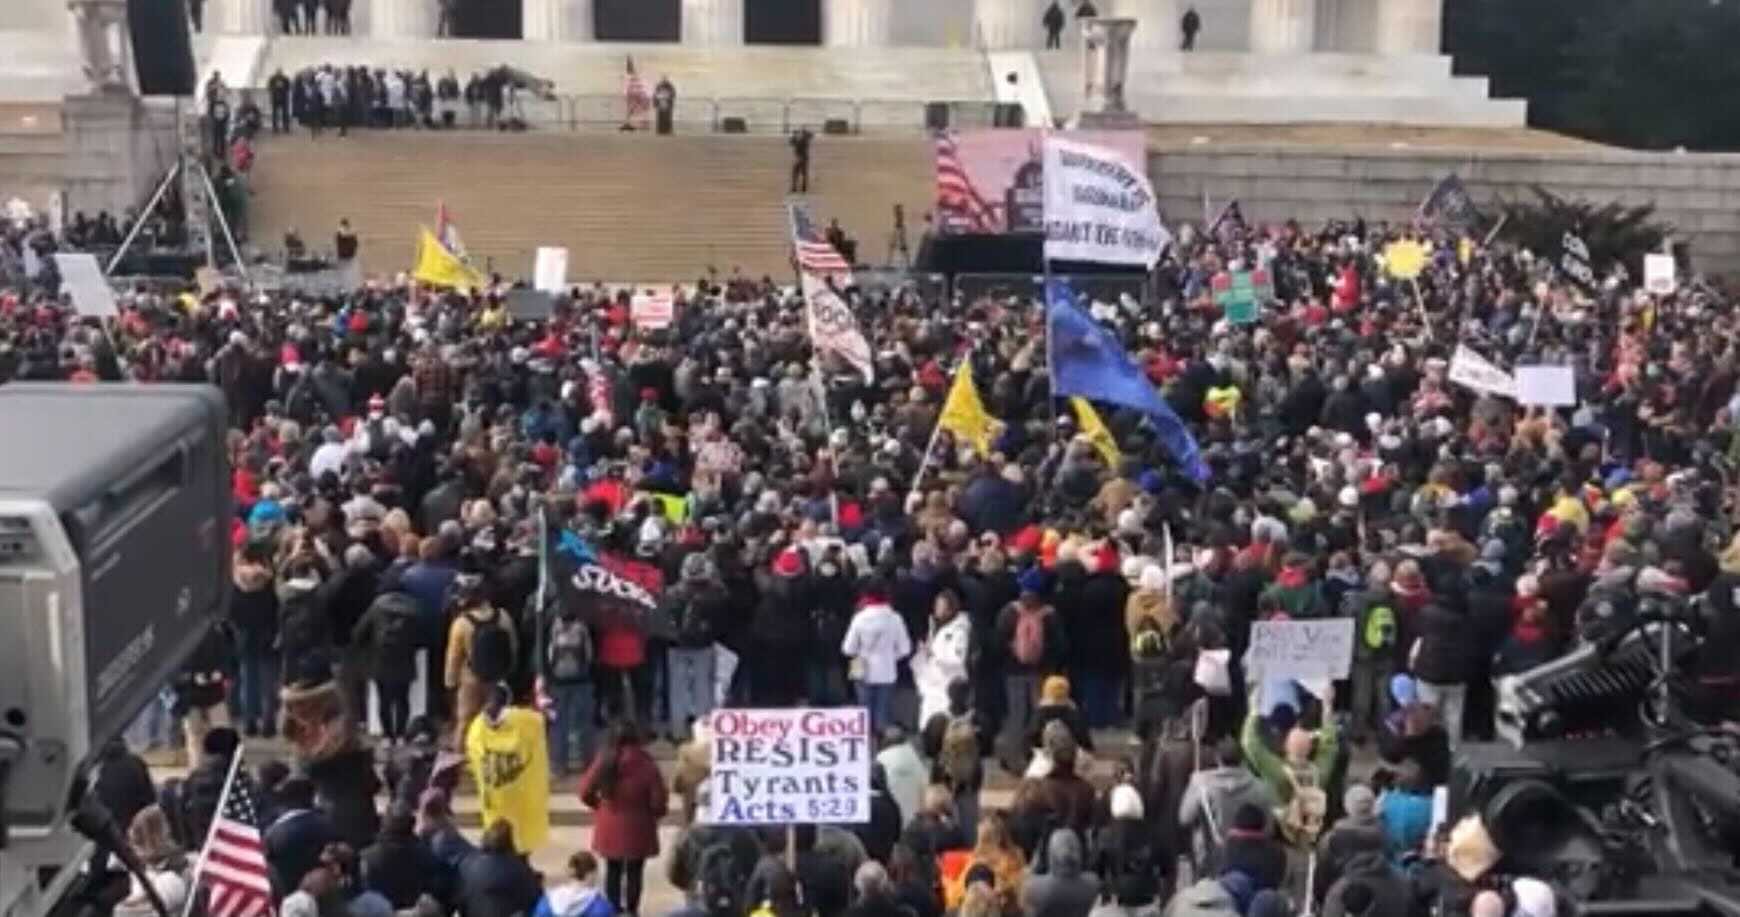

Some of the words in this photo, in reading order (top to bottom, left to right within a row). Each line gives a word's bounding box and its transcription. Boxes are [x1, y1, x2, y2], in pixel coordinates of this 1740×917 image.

[714, 711, 793, 742] Obey
[801, 711, 865, 736] God
[716, 737, 865, 767] RESIST
[715, 770, 859, 801] Tyrants
[719, 796, 796, 820] Acts
